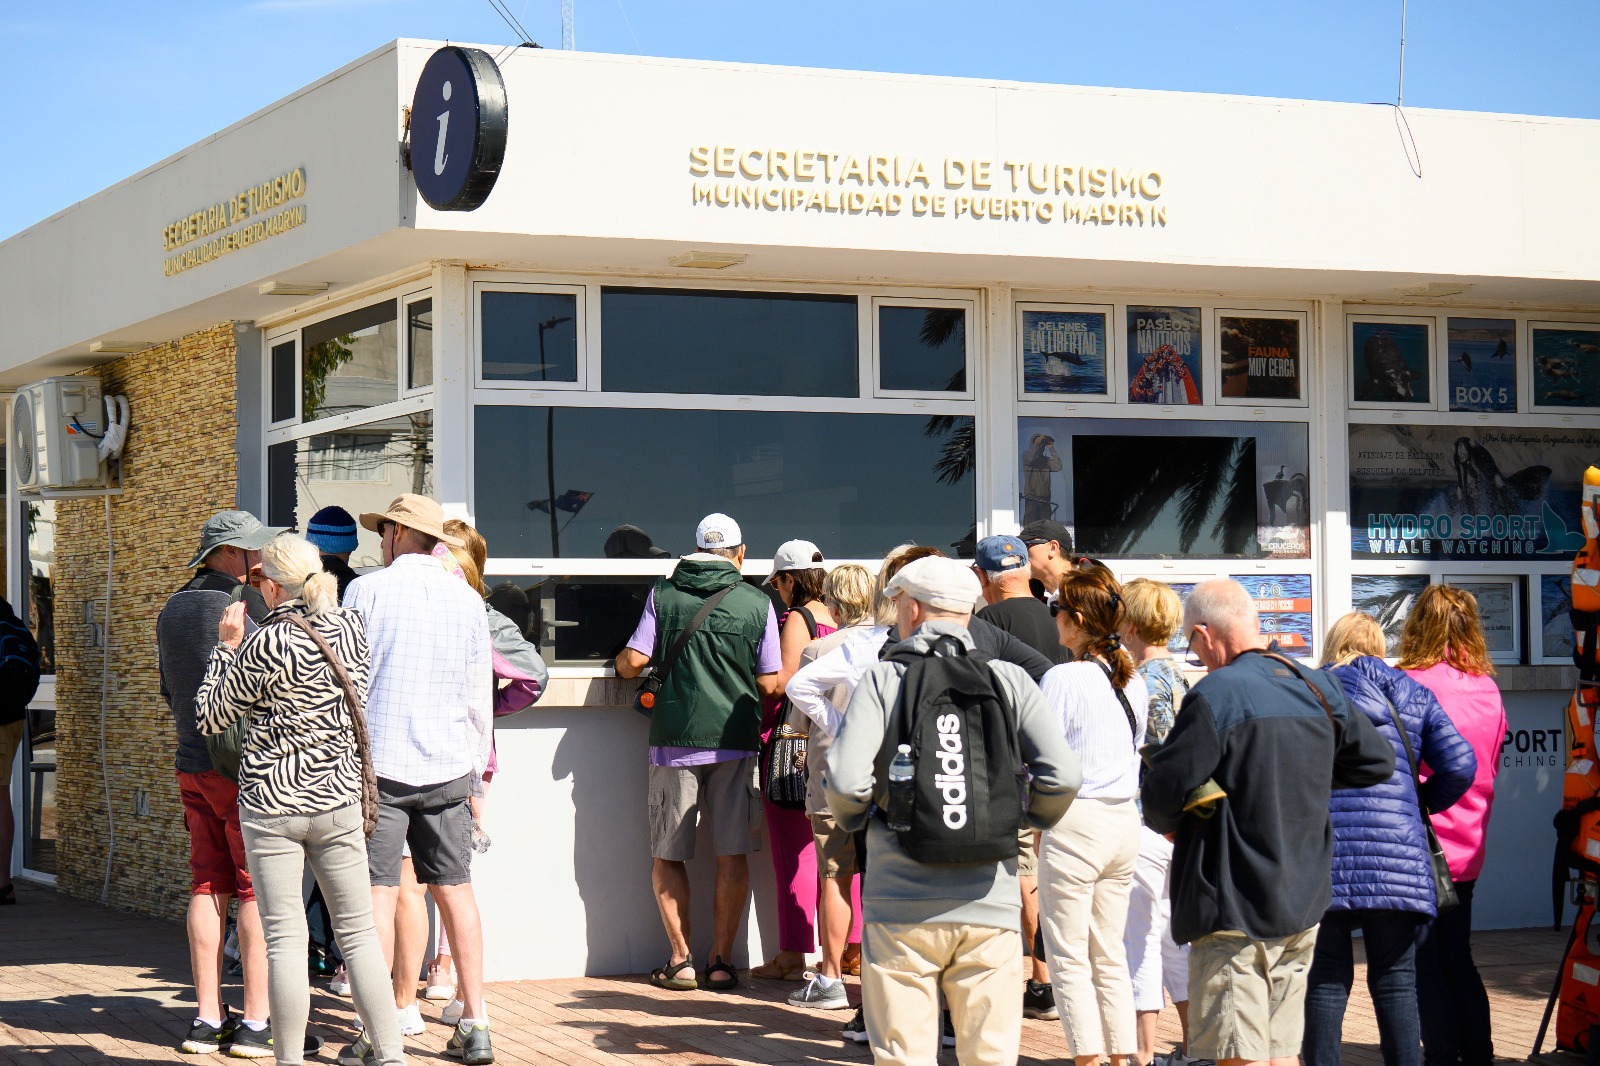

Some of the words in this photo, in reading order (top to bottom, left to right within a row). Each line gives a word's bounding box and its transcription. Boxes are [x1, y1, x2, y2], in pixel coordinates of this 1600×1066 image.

[689, 145, 930, 187] SECRETARIA
[944, 157, 993, 190] DE
[1003, 159, 1163, 200] TURISMO
[162, 202, 231, 251] SECRETARIA
[230, 192, 249, 224] DE
[249, 167, 306, 215] TURISMO
[692, 181, 902, 216] MUNICIPALIDAD
[912, 193, 947, 217] DE
[955, 195, 1054, 222] PUERTO
[1063, 199, 1168, 227] MADRYN
[163, 239, 223, 276] MUNICIPALIDAD
[221, 235, 235, 255] DE
[233, 222, 267, 250] PUERTO
[265, 205, 306, 237] MADRYN
[1037, 321, 1088, 332] DELFINES
[1136, 318, 1191, 331] PASEOS
[1030, 330, 1046, 354] EN
[1047, 330, 1097, 356] LIBERTAD
[1247, 346, 1290, 359] FAUNA
[1248, 357, 1267, 377] MUY
[1268, 358, 1295, 378] CERCA
[1455, 386, 1494, 404] BOX
[1498, 387, 1508, 404] 5
[1358, 451, 1393, 459] AVISTAJE
[1395, 451, 1405, 460] DE
[1396, 467, 1407, 476] DE
[1368, 513, 1453, 540] HYDRO
[1459, 514, 1542, 540] SPORT
[1369, 540, 1431, 554] WHALE
[1441, 540, 1536, 555] WATCHING
[936, 713, 968, 830] adidas
